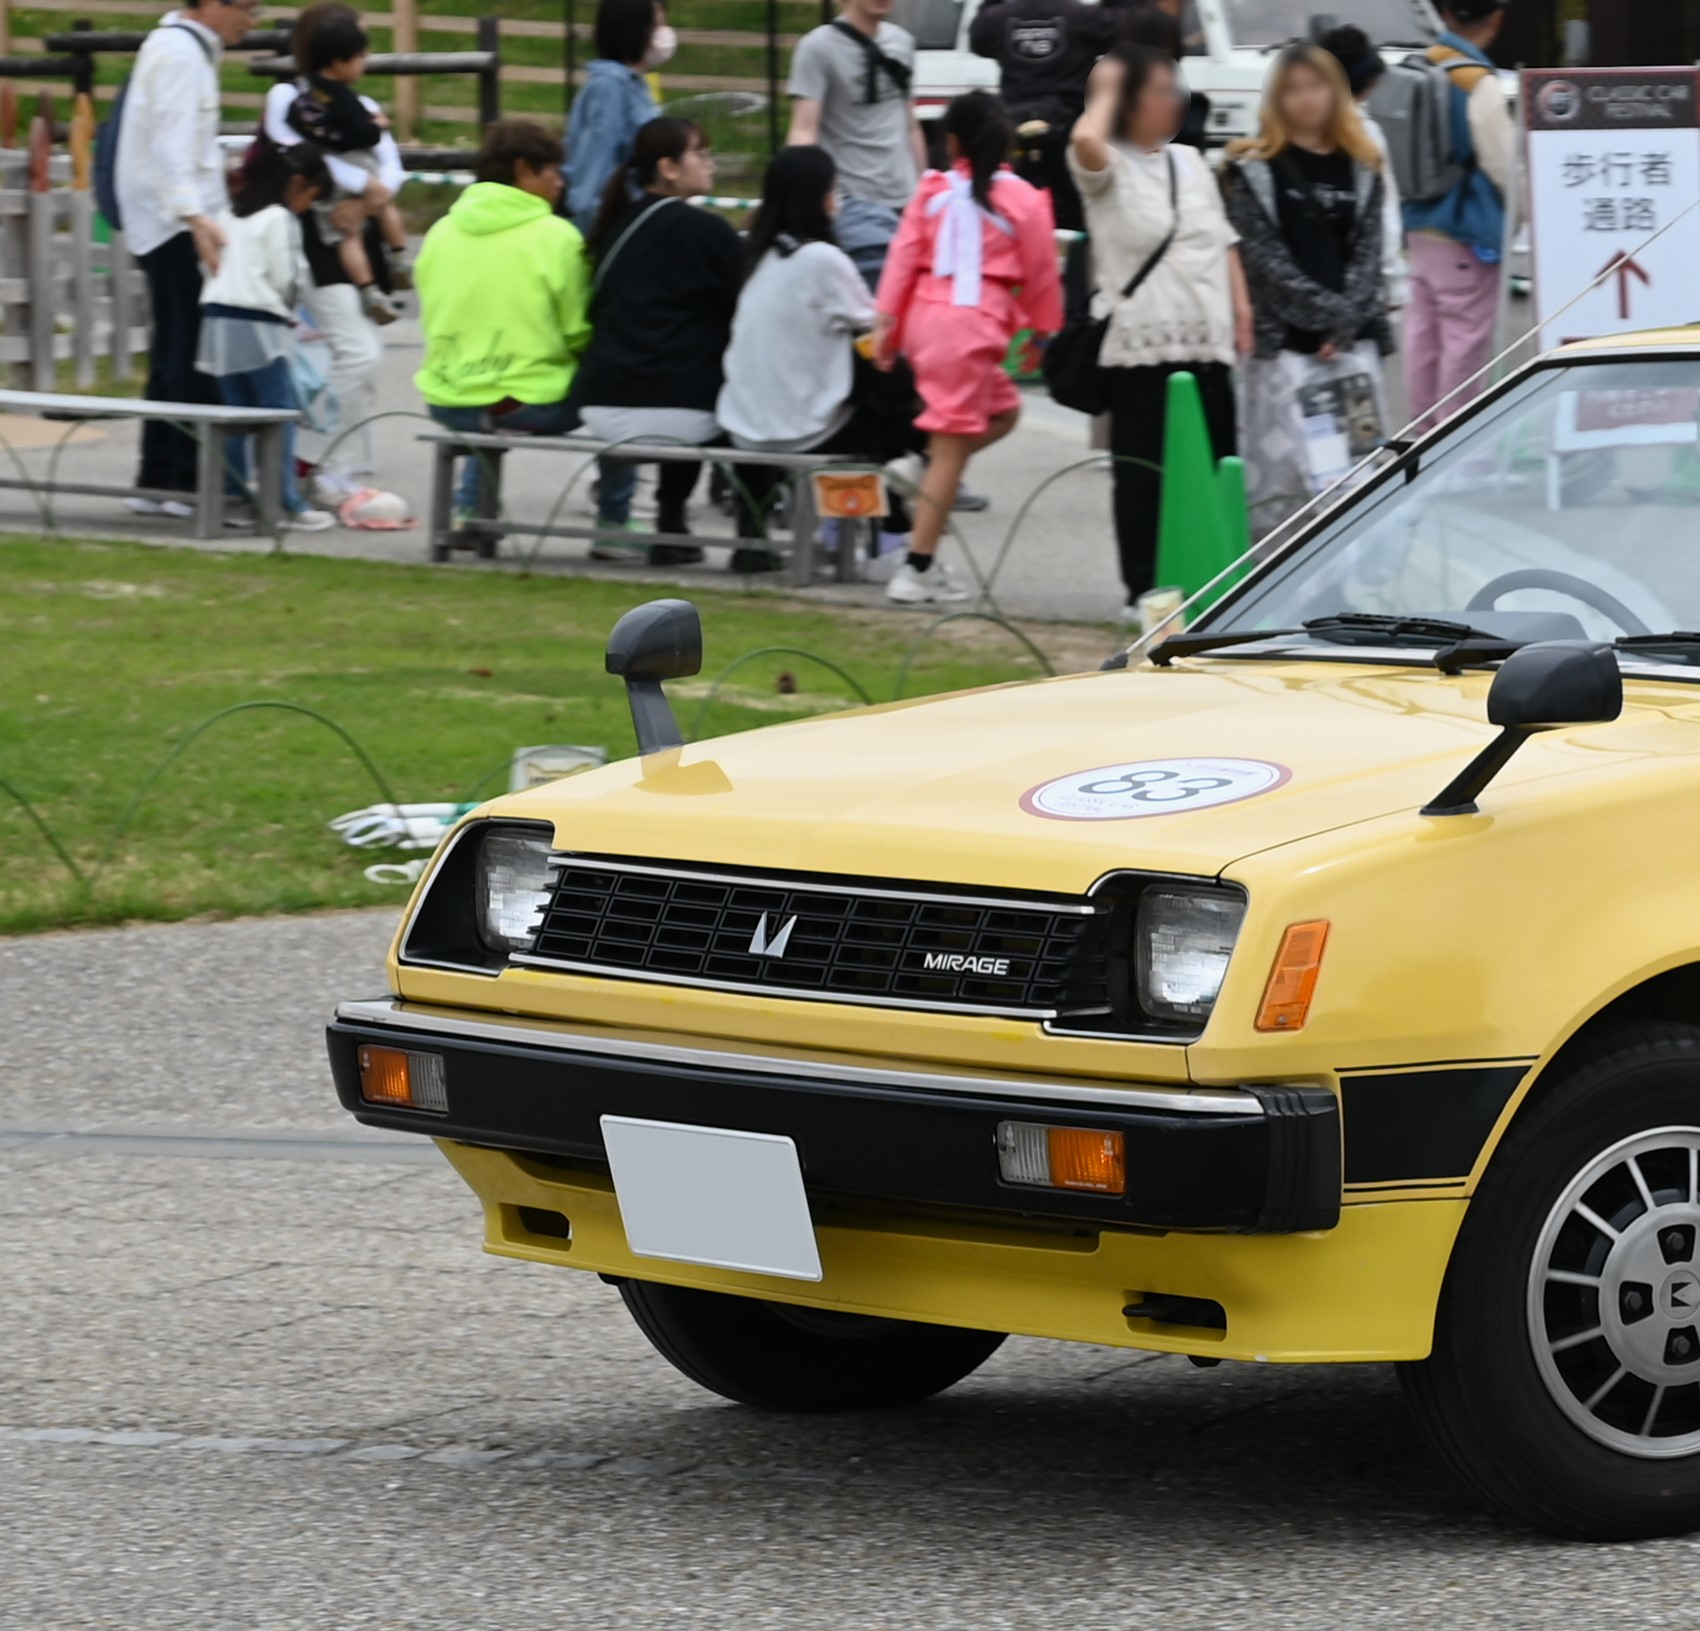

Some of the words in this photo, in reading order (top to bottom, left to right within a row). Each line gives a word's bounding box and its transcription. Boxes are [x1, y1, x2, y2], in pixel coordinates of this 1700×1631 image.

[1561, 152, 1672, 188] 歩行者
[1583, 197, 1657, 232] 通路
[1078, 770, 1233, 802] 83
[923, 952, 1010, 976] MIRAGE
